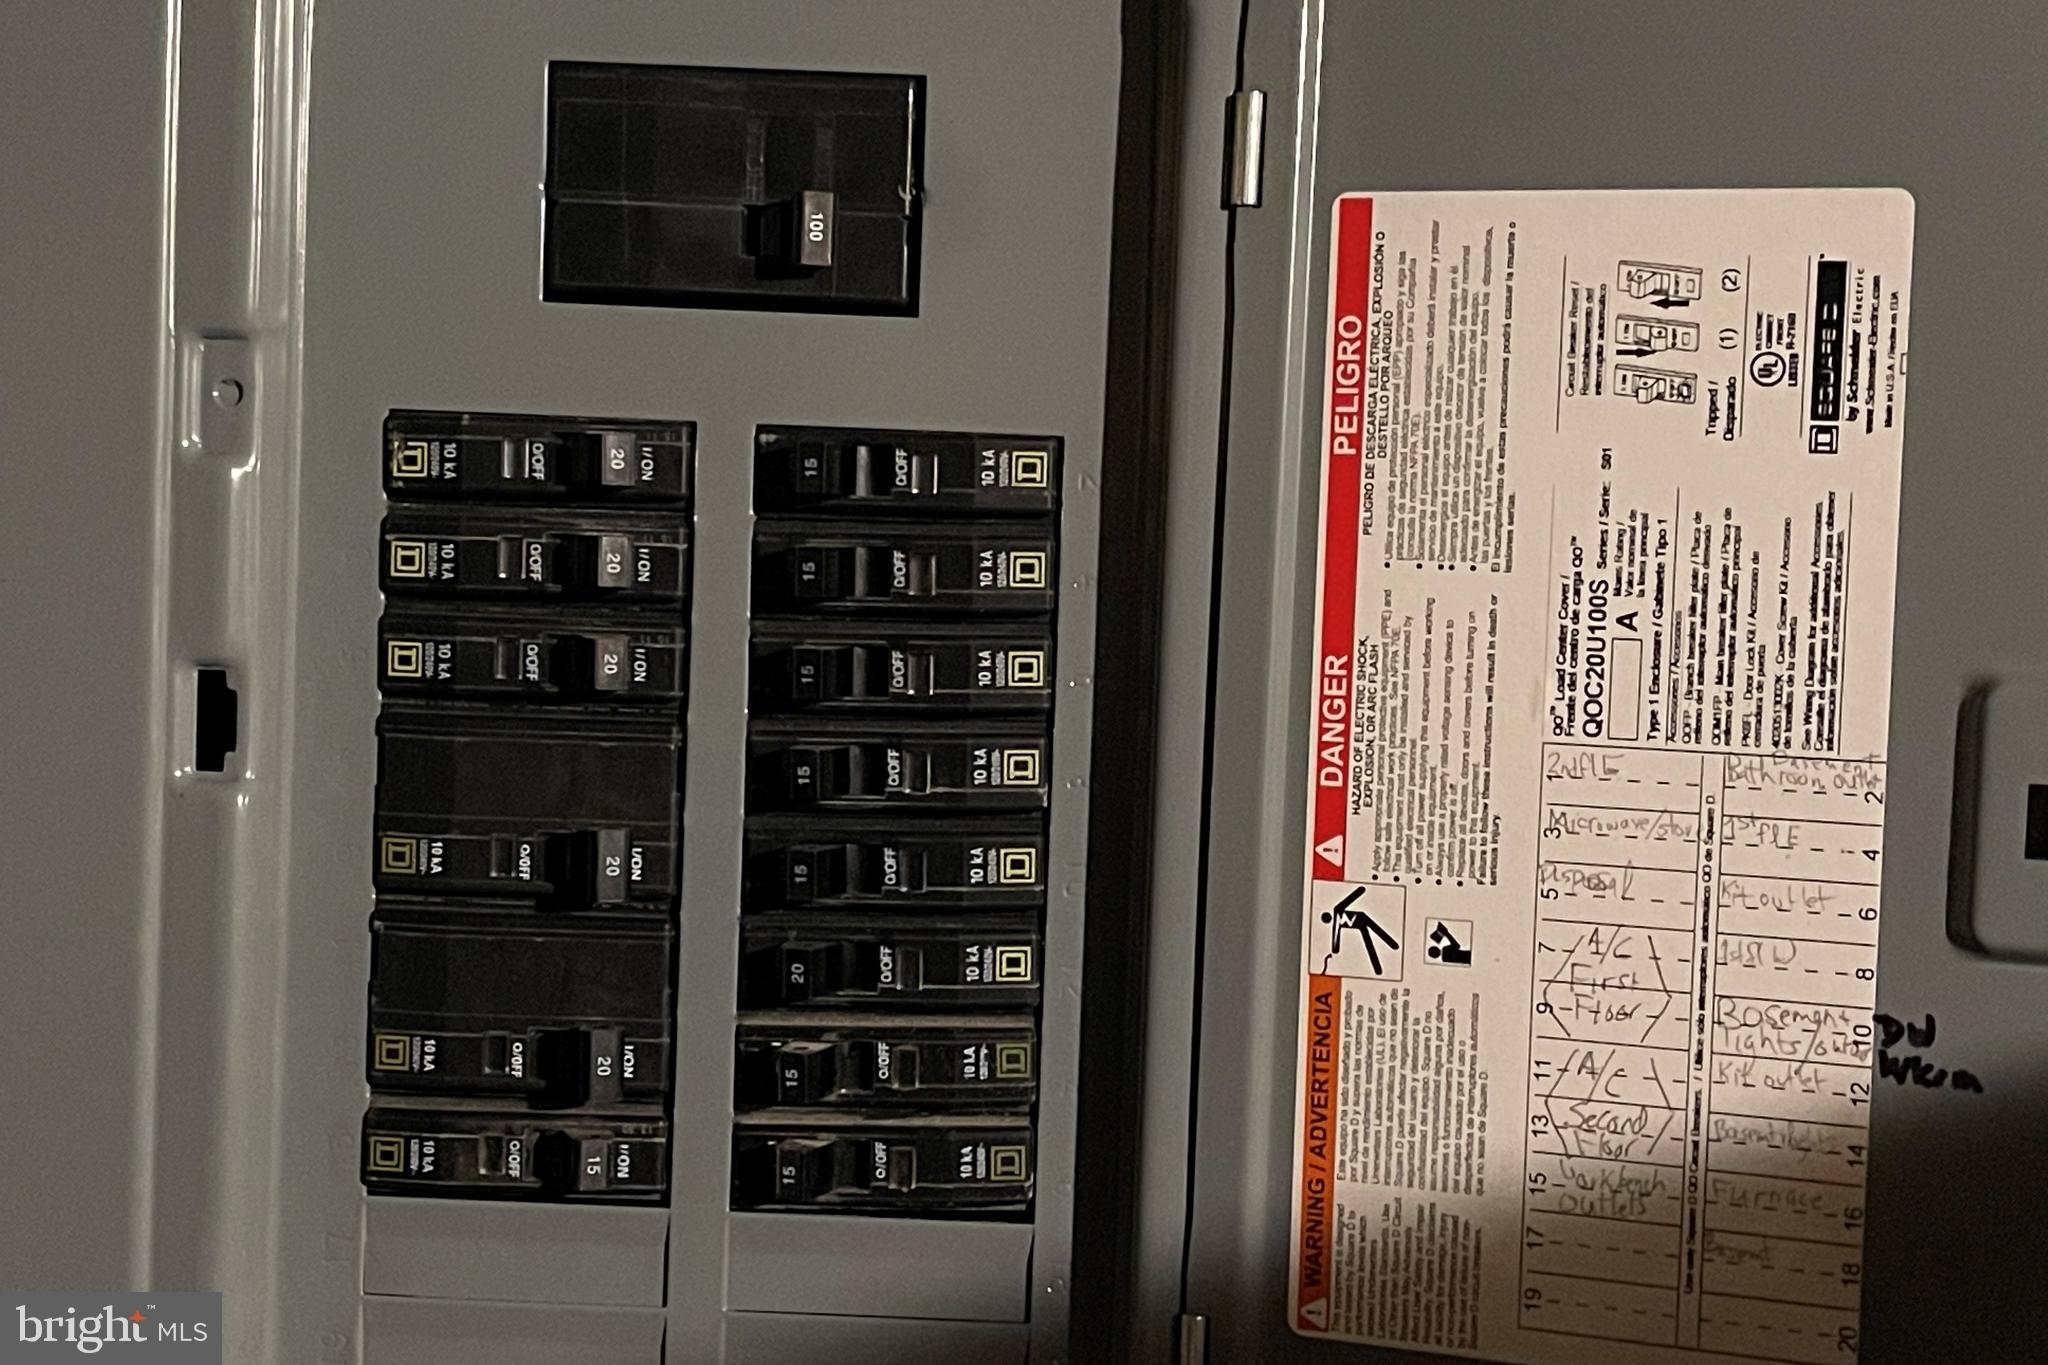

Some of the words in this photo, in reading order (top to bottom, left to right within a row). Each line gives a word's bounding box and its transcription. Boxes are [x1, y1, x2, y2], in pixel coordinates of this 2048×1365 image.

[809, 212, 824, 242] 100
[1376, 231, 1385, 239] O
[1370, 243, 1385, 313] EXPLOSIÓN
[1721, 268, 1741, 291] (2)
[1851, 267, 1864, 323] Electric
[1380, 310, 1393, 362] ARQUEO
[1718, 328, 1738, 349] (1)
[1367, 316, 1383, 388] ELÉCTRICA,
[1332, 315, 1362, 455] PELIGRO
[1379, 366, 1390, 391] POR
[1705, 389, 1720, 435] Tripped
[1845, 406, 1859, 421] by
[1366, 392, 1378, 459] DESCARGA
[1376, 394, 1389, 457] DESTELLO
[443, 443, 457, 457] 10
[610, 448, 625, 470] 20
[982, 449, 996, 466] kA
[1601, 447, 1612, 469] S01
[443, 461, 457, 480] kA
[804, 457, 818, 477] 15
[982, 468, 995, 486] 10
[1365, 462, 1375, 478] DE
[1363, 482, 1375, 535] PELIGRO
[441, 544, 455, 559] 10
[1597, 528, 1608, 569] Series
[1656, 529, 1668, 556] Tipo
[606, 553, 620, 574] 20
[980, 550, 993, 567] kA
[441, 562, 455, 580] kA
[802, 561, 816, 582] 15
[980, 570, 993, 588] 10
[1572, 571, 1583, 605] carga
[1653, 562, 1665, 618] Gabinete
[1558, 582, 1569, 619] Cover
[1570, 609, 1580, 624] de
[1615, 611, 1638, 631] A
[438, 644, 451, 658] 10
[1556, 624, 1568, 665] Center
[1569, 628, 1579, 668] centro
[603, 653, 618, 675] 20
[978, 650, 991, 667] kA
[1356, 635, 1369, 680] SHOCK,
[1368, 643, 1379, 682] FLASH
[1582, 578, 1610, 737] QOC20U100S
[1649, 630, 1662, 694] Enclosure
[438, 662, 451, 680] kA
[801, 664, 814, 685] 15
[978, 669, 991, 687] 10
[1567, 672, 1577, 691] del
[1554, 669, 1566, 700] Load
[1366, 687, 1377, 711] ARC
[1319, 654, 1348, 787] DANGER
[1354, 685, 1365, 742] ELECTRIC
[1365, 715, 1376, 732] OR
[1565, 695, 1576, 736] Frente
[1647, 709, 1659, 740] Type
[974, 748, 987, 765] kA
[1353, 746, 1363, 762] OF
[797, 765, 811, 784] 15
[974, 768, 987, 785] 10
[1362, 738, 1376, 807] EXPLOSION,
[1546, 773, 1563, 783] 1
[1351, 765, 1362, 815] HAZARD
[1865, 791, 1883, 804] 2
[1543, 826, 1561, 839] 3
[430, 841, 444, 855] 10
[971, 847, 984, 863] kA
[1862, 849, 1879, 861] 4
[430, 857, 444, 874] kA
[605, 856, 620, 877] 20
[794, 864, 807, 883] 15
[970, 867, 983, 884] 10
[1541, 887, 1558, 900] 5
[1860, 907, 1877, 920] 6
[966, 945, 979, 962] kA
[1539, 942, 1556, 954] 7
[791, 963, 805, 984] 20
[966, 964, 979, 982] 10
[1856, 968, 1874, 980] 8
[1536, 1002, 1553, 1014] 9
[423, 1039, 435, 1053] 10
[1854, 1025, 1872, 1050] 10
[423, 1055, 435, 1071] kA
[964, 1046, 976, 1061] kA
[597, 1056, 611, 1077] 20
[964, 1064, 976, 1080] 10
[1308, 990, 1333, 1158] ADVERTENCIA
[1534, 1059, 1550, 1080] 11
[785, 1068, 798, 1087] 15
[1852, 1082, 1869, 1106] 12
[1532, 1115, 1549, 1137] 13
[422, 1141, 435, 1155] 10
[960, 1146, 973, 1161] kA
[1848, 1145, 1866, 1167] 14
[422, 1157, 435, 1173] kA
[587, 1155, 600, 1175] 15
[782, 1166, 796, 1184] 15
[960, 1163, 973, 1179] 10
[1530, 1172, 1546, 1194] 15
[1845, 1208, 1863, 1229] 16
[1303, 1177, 1325, 1288] WARNING
[1527, 1229, 1544, 1250] 17
[1842, 1263, 1859, 1287] 18
[1525, 1288, 1541, 1310] 19
[1839, 1327, 1857, 1352] 20
